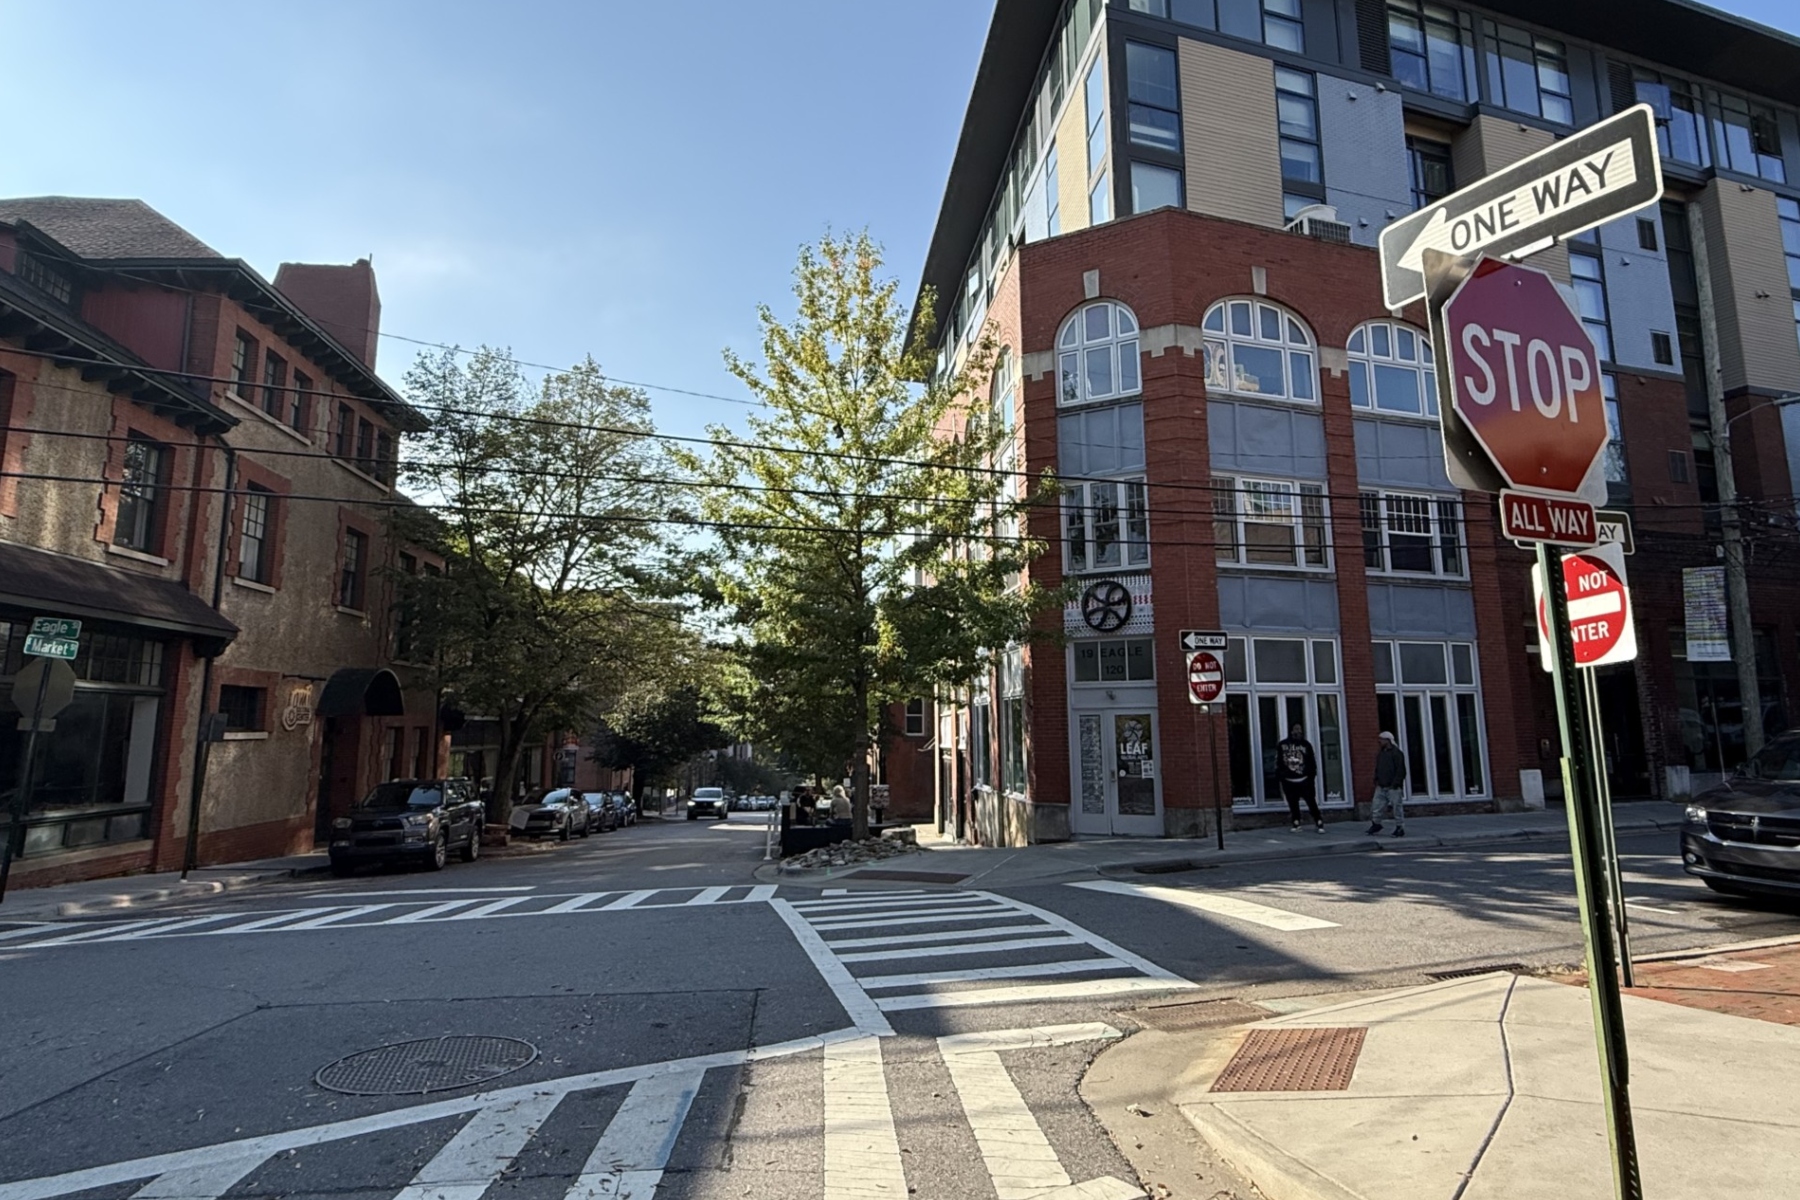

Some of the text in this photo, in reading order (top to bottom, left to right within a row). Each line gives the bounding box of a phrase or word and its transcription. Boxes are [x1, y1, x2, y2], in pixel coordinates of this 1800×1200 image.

[1451, 150, 1615, 251] ONE WAY
[1461, 322, 1591, 423] STOP
[1511, 502, 1588, 536] ALL WAY
[1599, 525, 1617, 540] AY
[1578, 570, 1609, 592] NOT
[34, 619, 68, 635] Eagle
[1570, 621, 1610, 643] NTER
[32, 638, 69, 655] Market
[1195, 636, 1223, 645] ONE WAY
[1081, 646, 1143, 659] 19 EAGLE
[1105, 665, 1124, 675] 120
[1192, 661, 1217, 670] DO NOT
[1196, 683, 1217, 692] ENTER
[1120, 742, 1148, 755] LEAF
